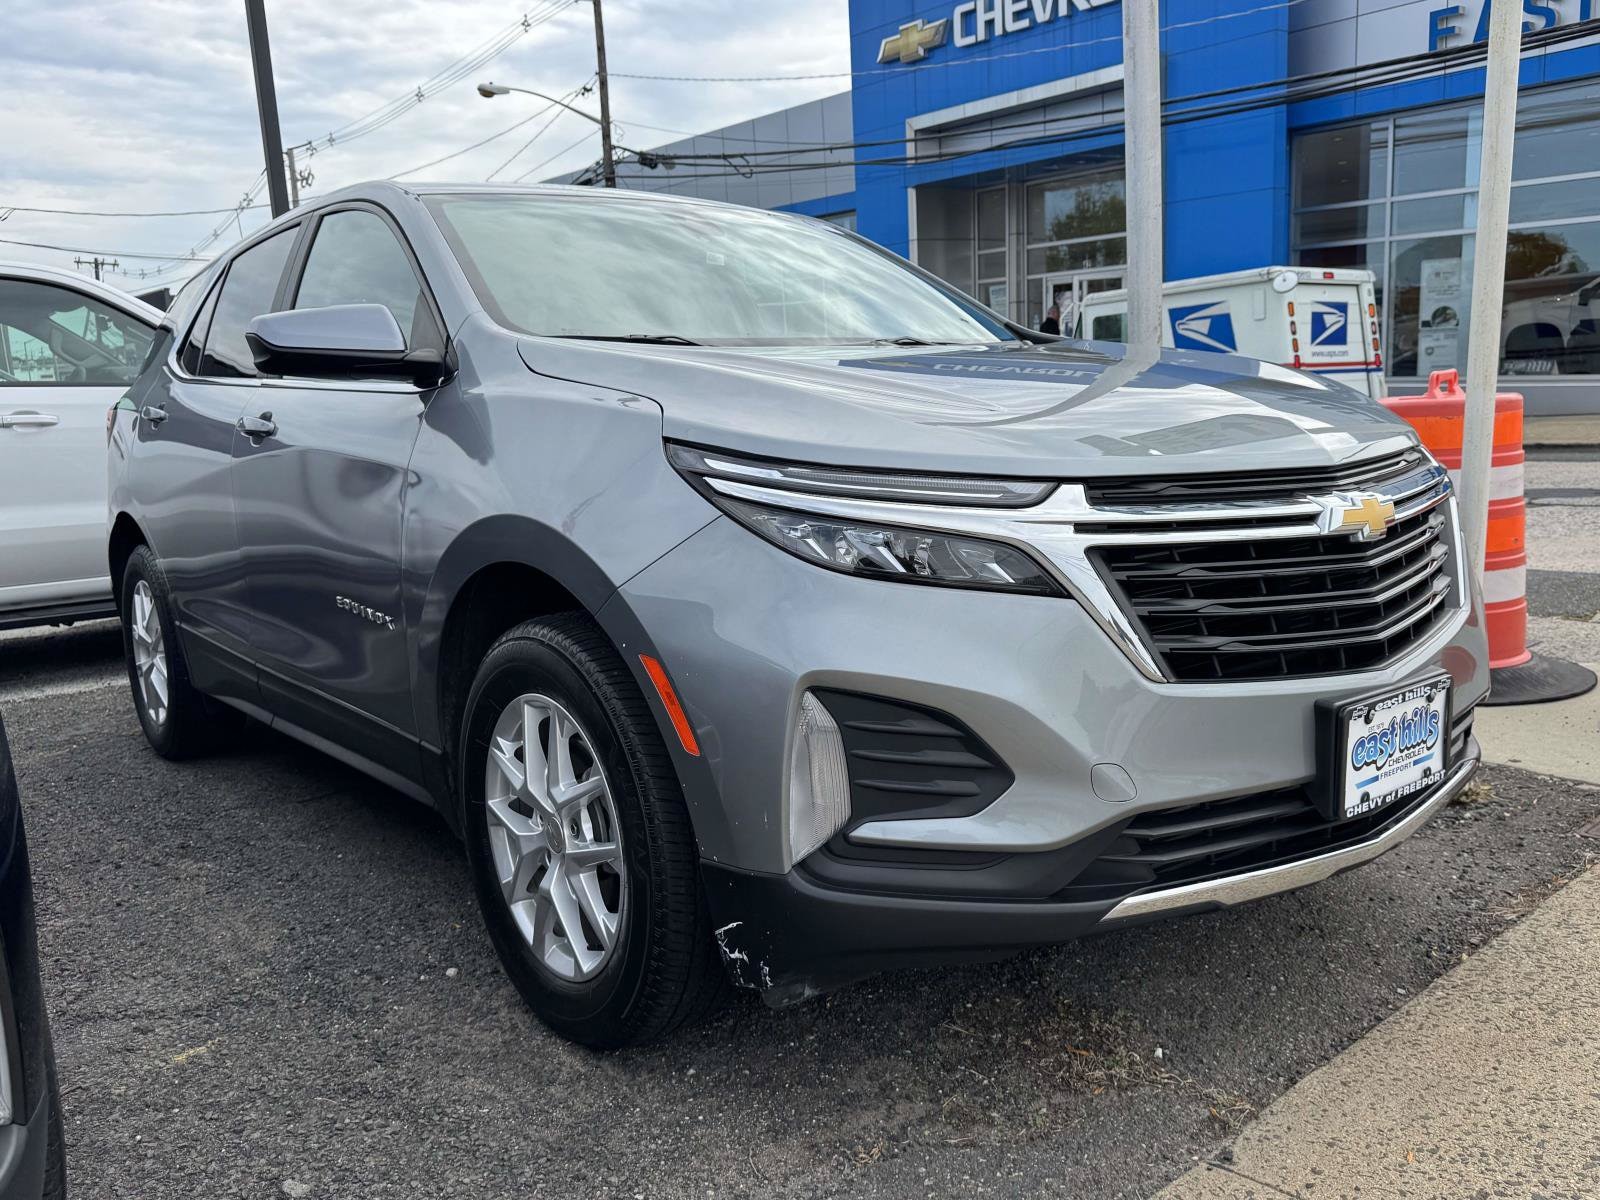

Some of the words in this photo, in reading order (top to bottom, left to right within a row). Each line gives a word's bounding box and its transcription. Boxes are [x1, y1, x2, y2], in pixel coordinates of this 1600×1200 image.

[952, 0, 1115, 48] CHEV
[336, 596, 396, 631] EQUINOX
[1375, 694, 1404, 711] east
[1405, 685, 1432, 701] hills
[1351, 716, 1398, 772] east
[1398, 705, 1440, 754] hills
[1380, 762, 1413, 780] FREEPORT
[1388, 746, 1426, 767] CHEVROLET
[1346, 795, 1384, 818] CHEVY
[1386, 792, 1396, 803] of
[1398, 770, 1446, 798] FREEPORT
